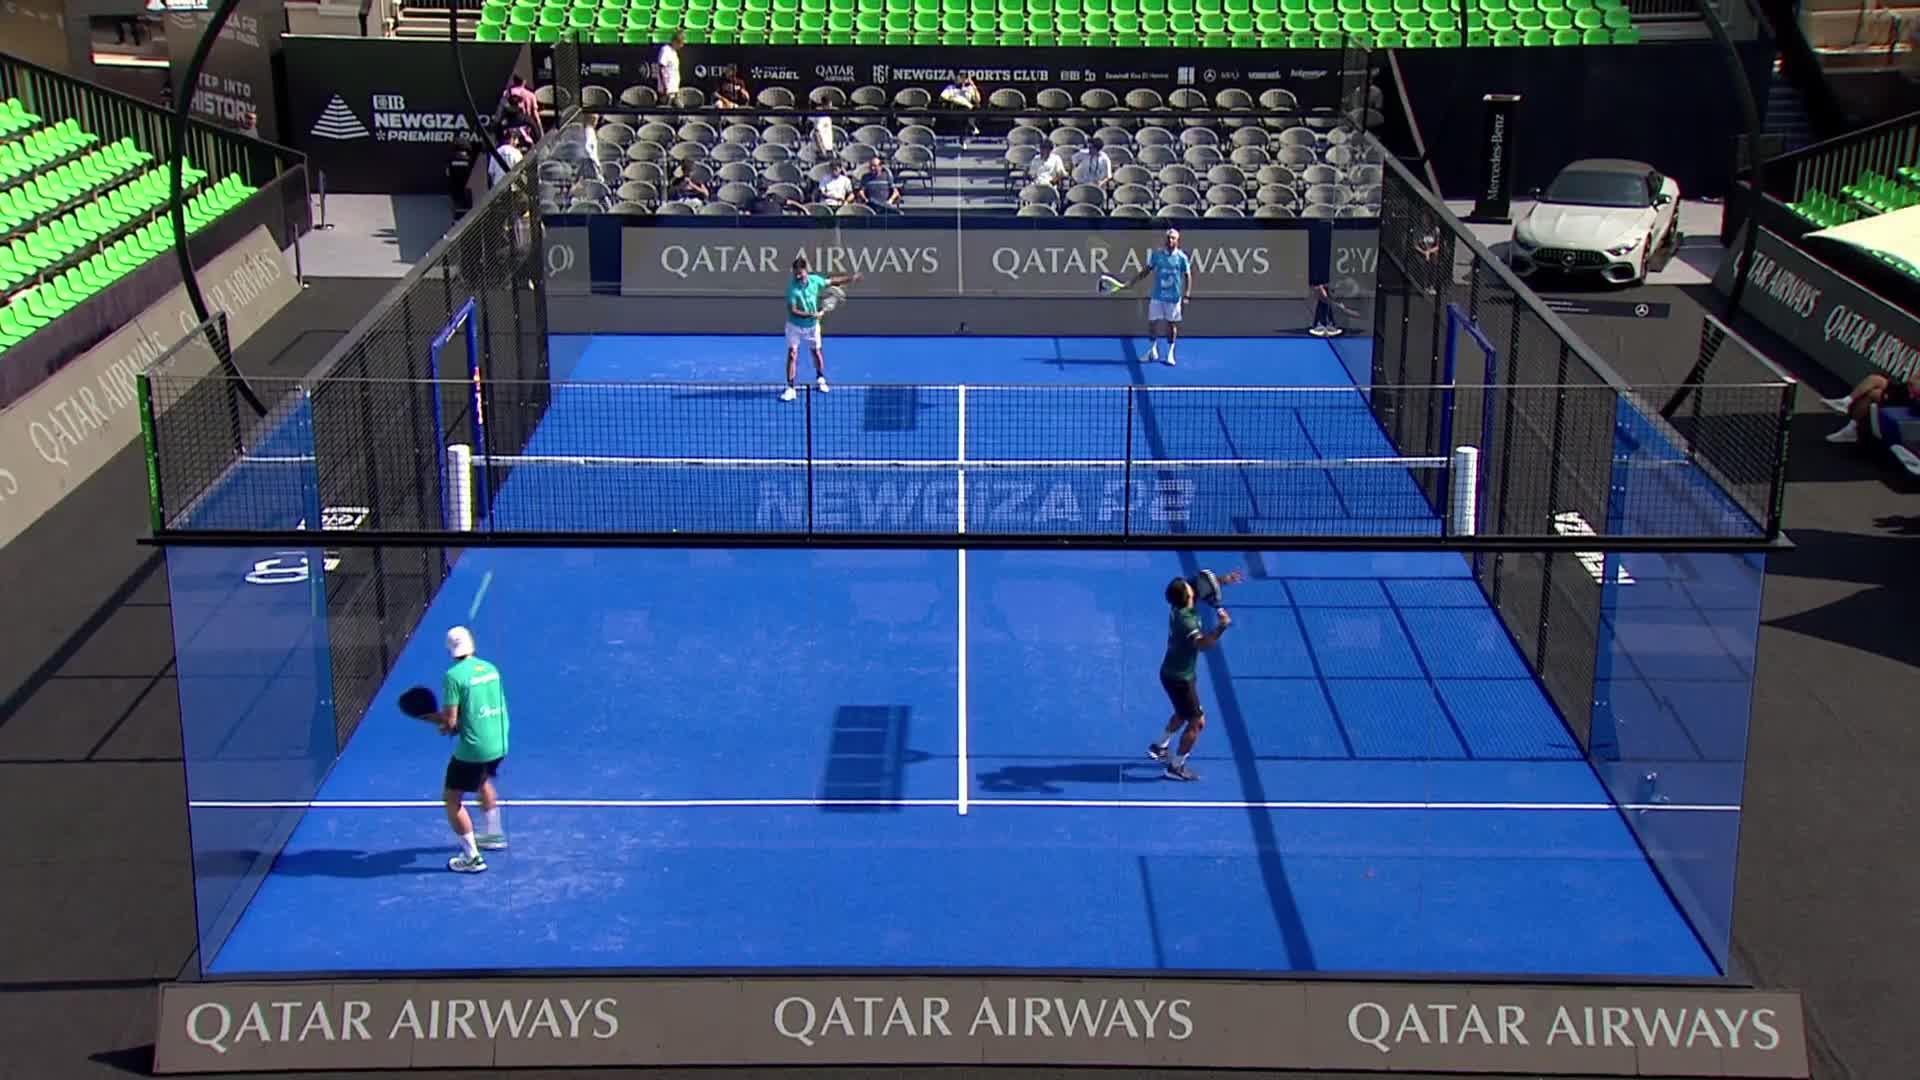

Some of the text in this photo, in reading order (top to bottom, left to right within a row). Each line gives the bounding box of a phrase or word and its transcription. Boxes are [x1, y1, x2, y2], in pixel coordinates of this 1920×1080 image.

[198, 73, 250, 95] TEP INTO
[815, 65, 854, 77] QATAR
[893, 69, 955, 80] NEWGIZA
[1013, 70, 1048, 81] CLUB
[374, 113, 469, 128] NEWGIZA
[388, 131, 454, 142] PREMIER
[1487, 114, 1505, 200] Mercedes-Benz
[660, 246, 780, 278] QATAR
[992, 248, 1270, 278] QATAR AIWAYS
[1768, 267, 1822, 318] AIRWAYS
[1824, 305, 1876, 354] QATAR
[29, 385, 109, 470] QATAR
[757, 479, 1080, 525] NEWGIZA
[186, 998, 619, 1053] QATAR AIRWAYS
[774, 997, 1194, 1046] QATAR AIRWAYS
[1347, 1003, 1781, 1052] QATAR AIRWAYS
